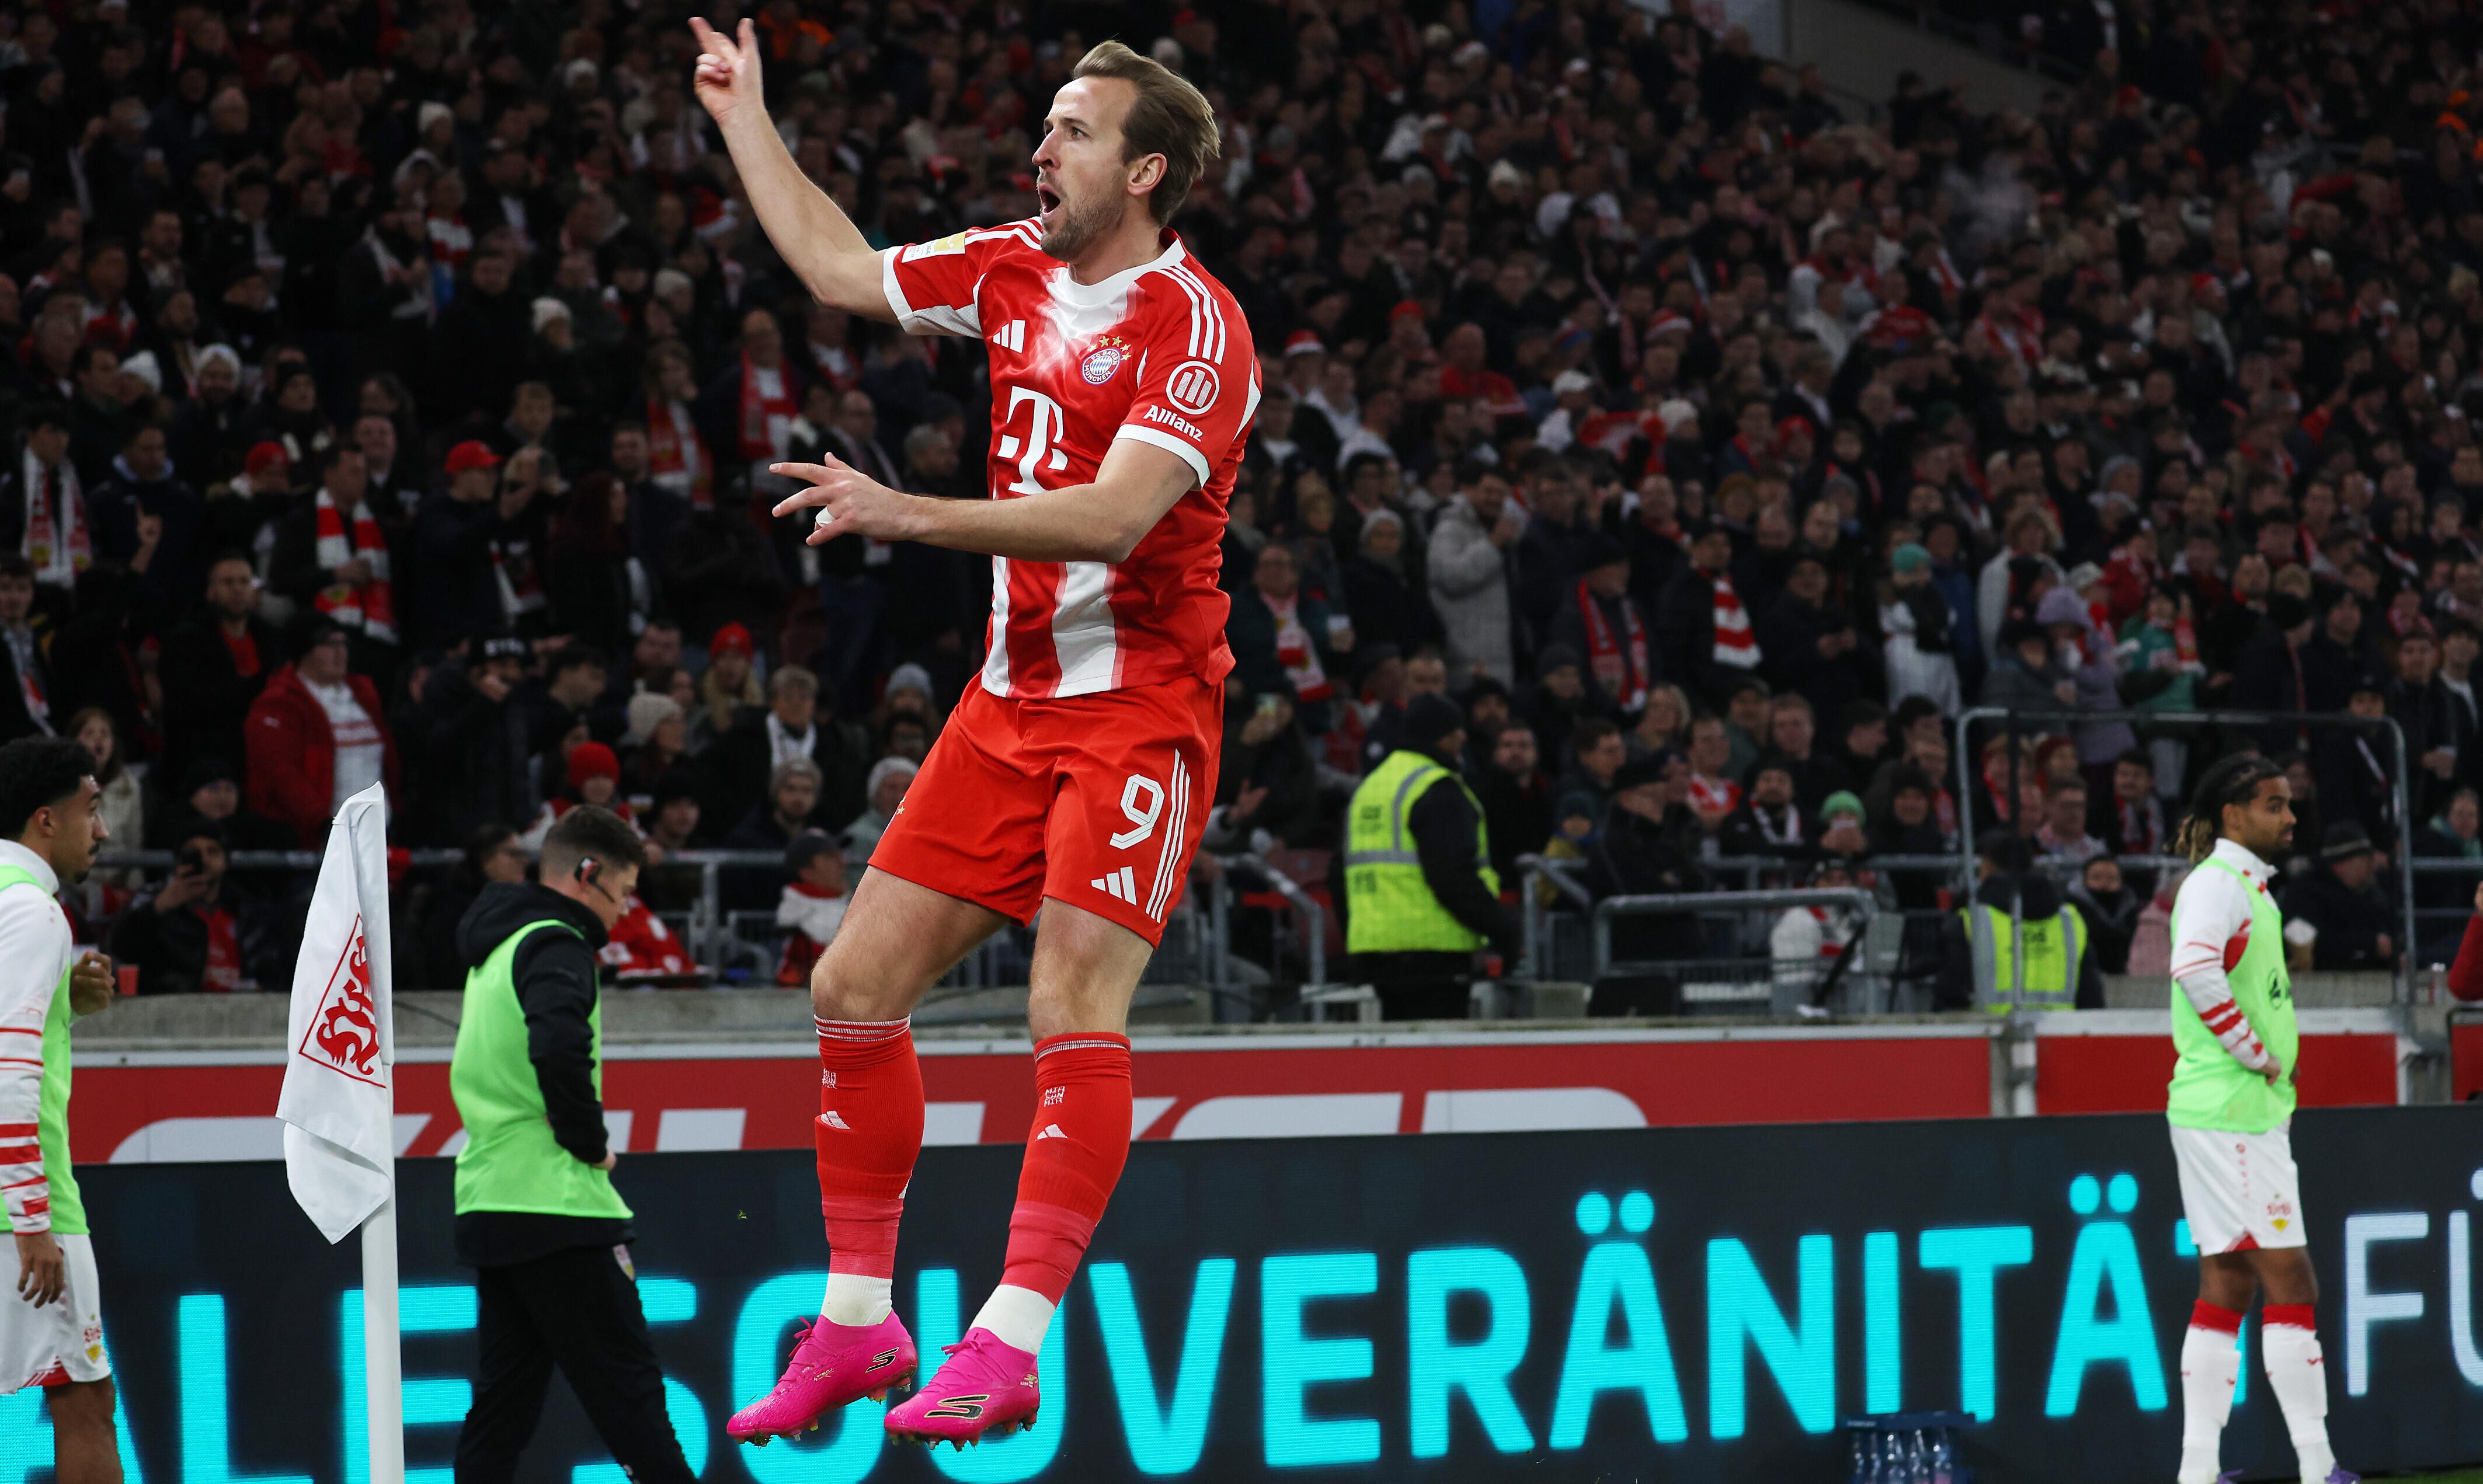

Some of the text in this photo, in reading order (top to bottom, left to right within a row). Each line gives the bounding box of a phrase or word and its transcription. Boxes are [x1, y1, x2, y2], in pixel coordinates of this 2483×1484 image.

[1102, 350, 1118, 365] BAYERN
[1143, 405, 1204, 443] Allianz
[1109, 774, 1166, 850] 9
[570, 1172, 2247, 1484] OUVERÄNITÄ
